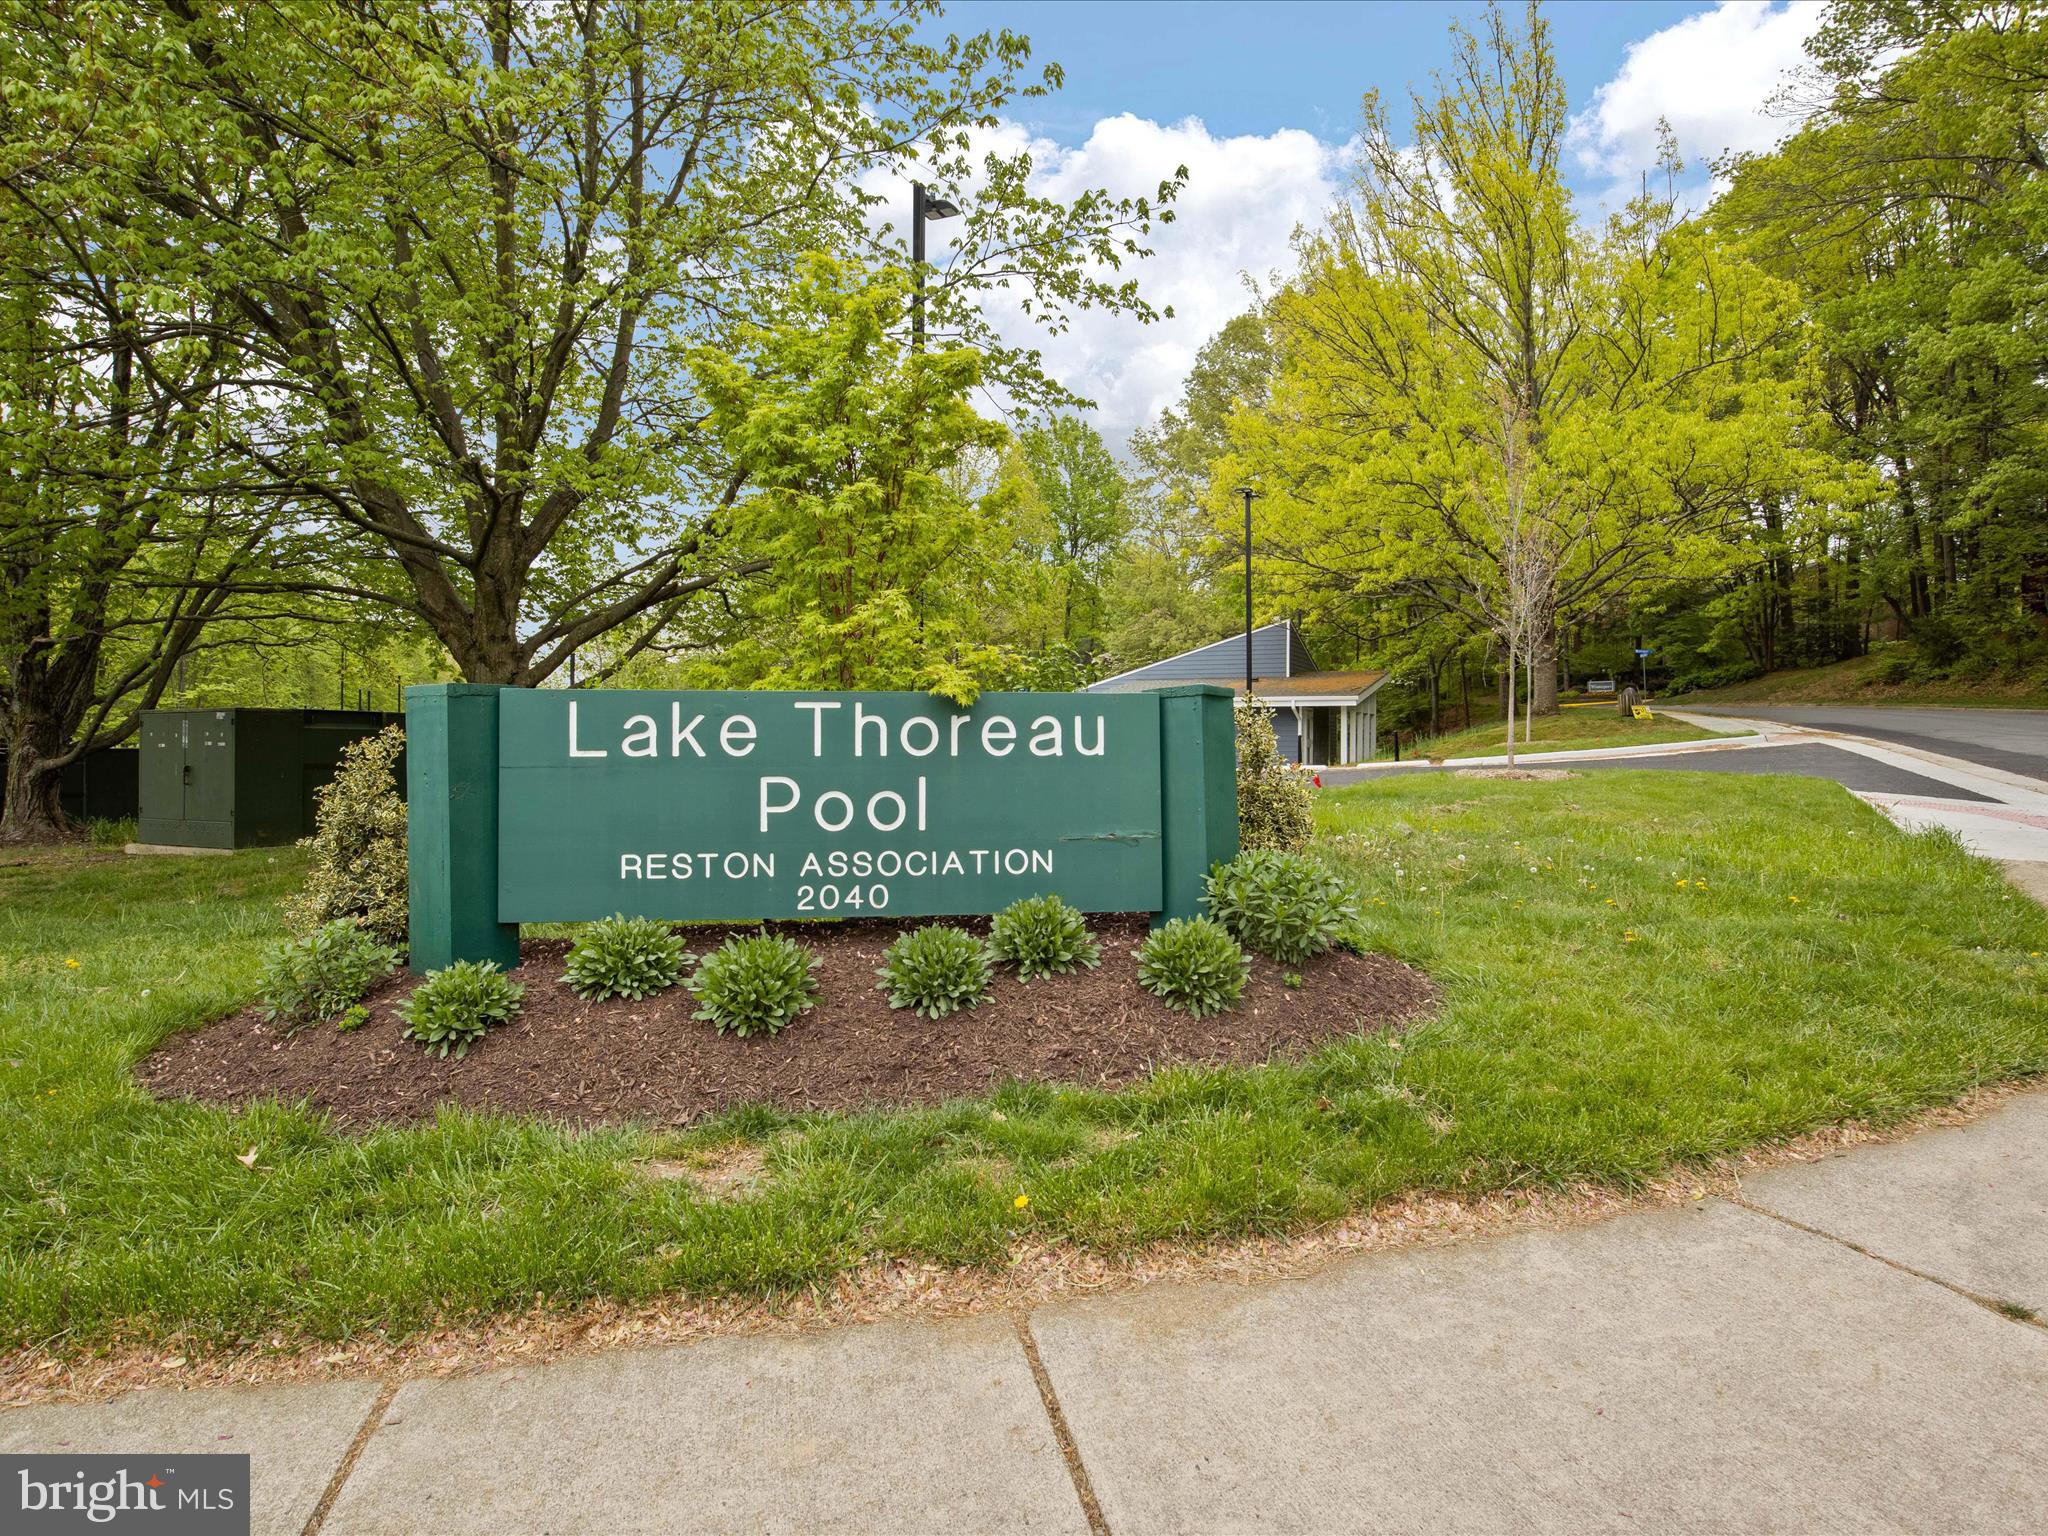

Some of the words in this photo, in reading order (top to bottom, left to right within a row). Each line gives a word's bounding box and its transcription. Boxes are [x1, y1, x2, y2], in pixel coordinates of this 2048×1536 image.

[568, 700, 758, 758] Lake
[793, 701, 1105, 757] Thoreau
[759, 775, 927, 833] Pool
[620, 851, 775, 880] RESTON
[799, 848, 1053, 878] ASSOCIATION
[796, 883, 889, 911] 2040
